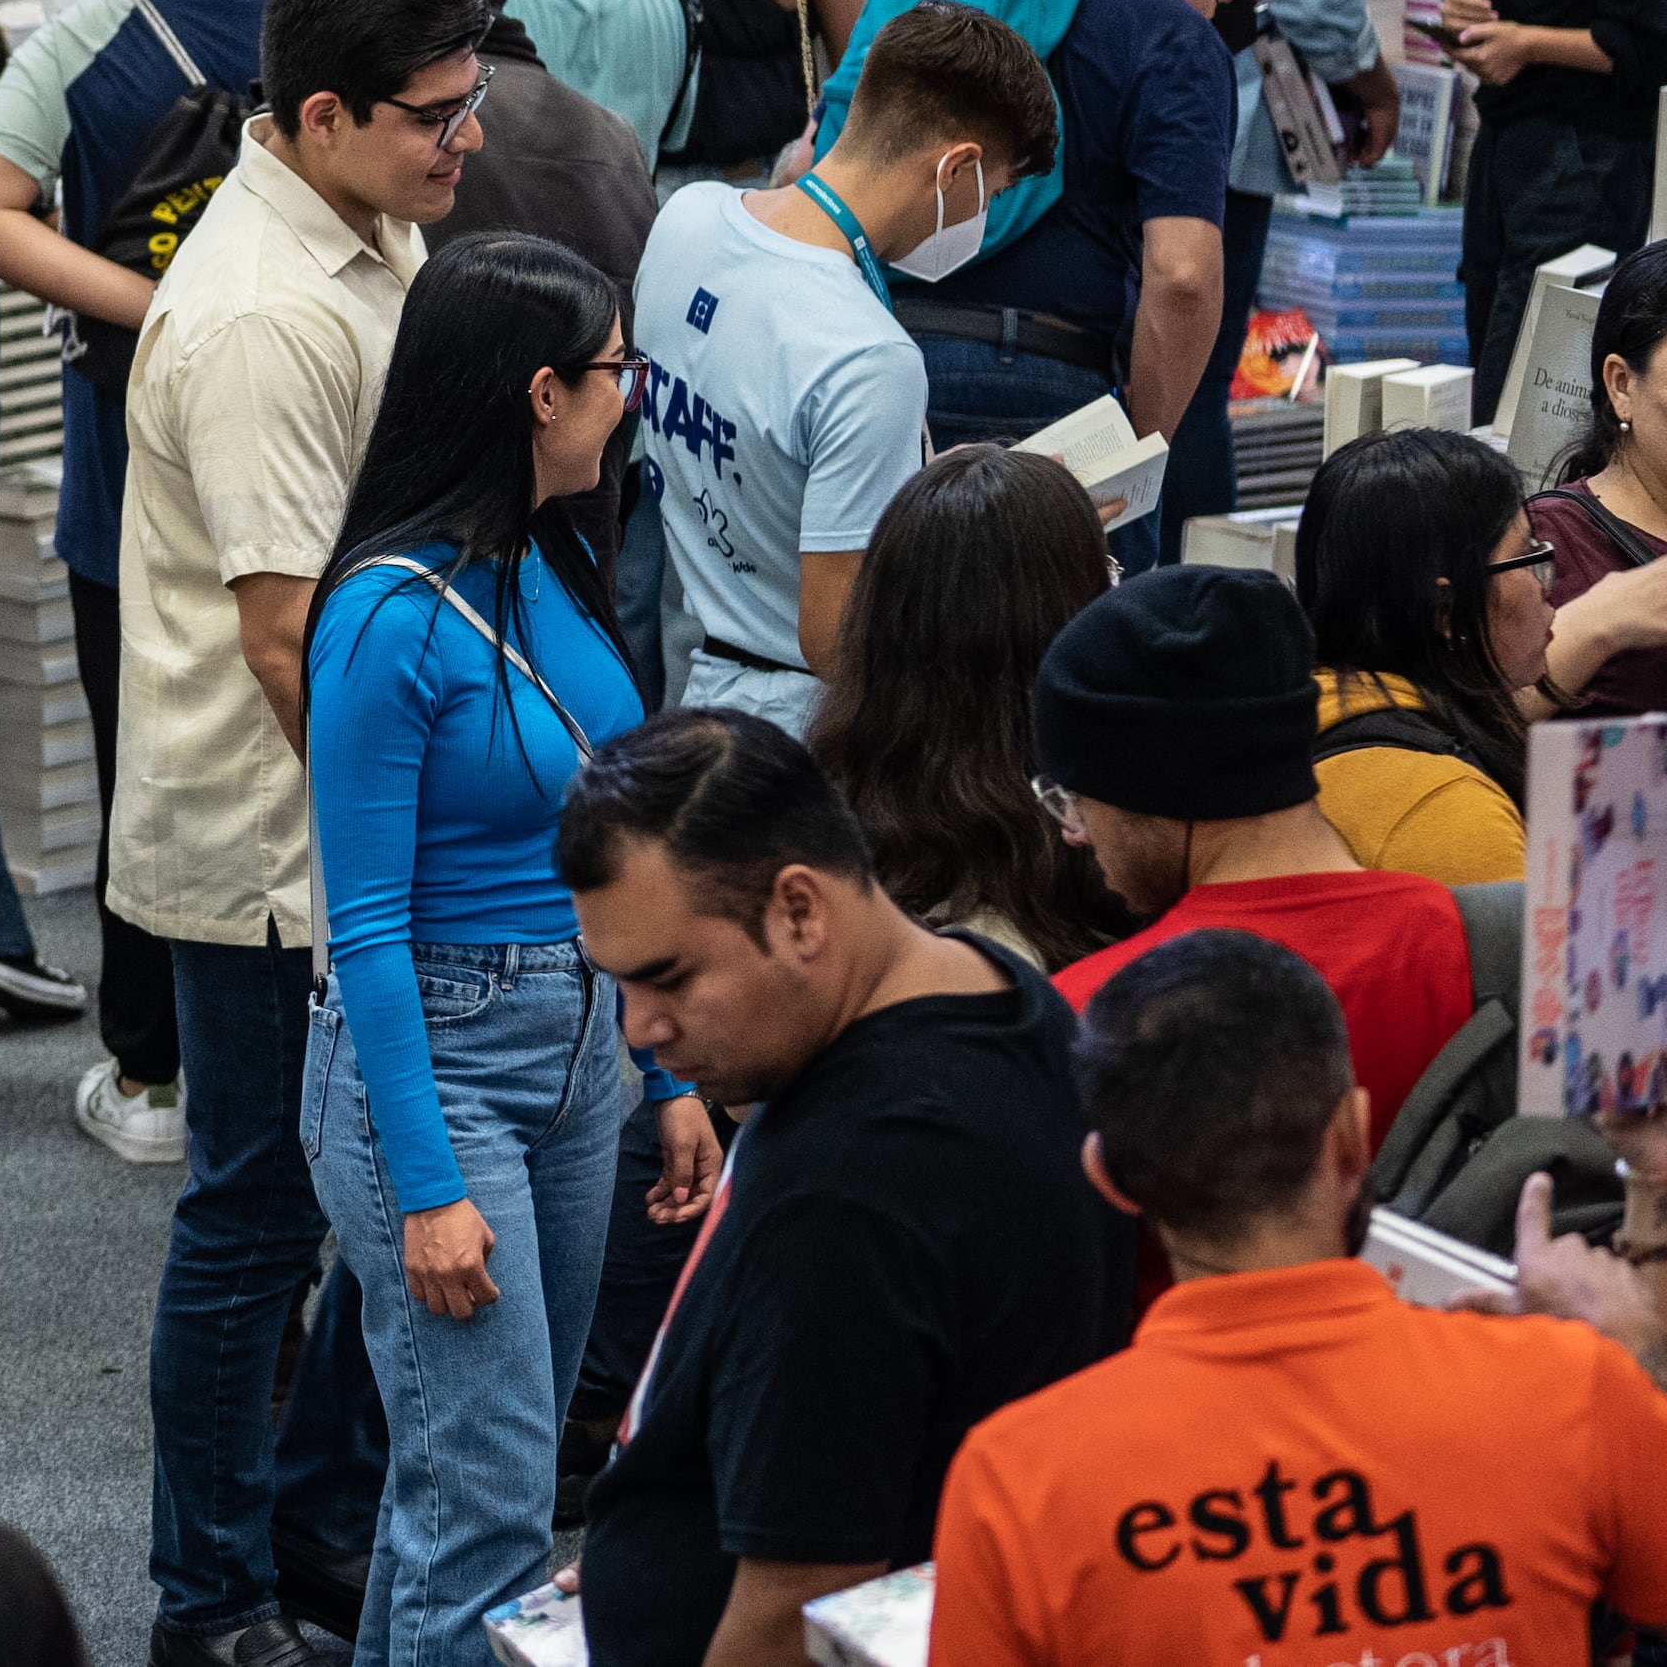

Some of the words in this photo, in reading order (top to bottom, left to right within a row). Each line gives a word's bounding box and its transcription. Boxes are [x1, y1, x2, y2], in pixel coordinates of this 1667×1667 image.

[1534, 367, 1553, 390] De
[1115, 1458, 1376, 1573] esta
[1234, 1508, 1514, 1642] vida
